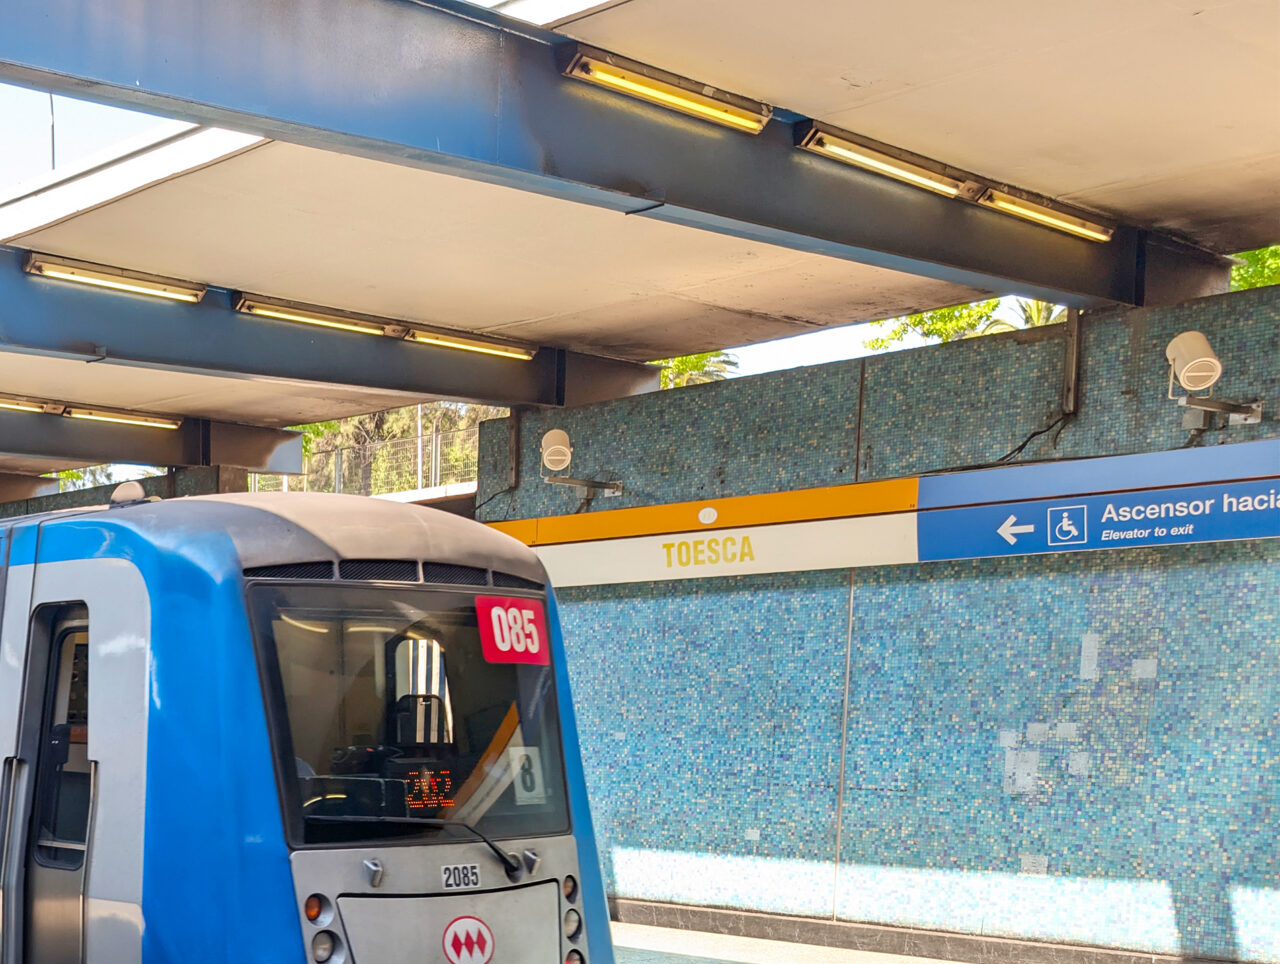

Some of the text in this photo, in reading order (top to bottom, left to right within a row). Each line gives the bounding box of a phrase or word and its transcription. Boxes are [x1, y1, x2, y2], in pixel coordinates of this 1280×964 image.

[1101, 489, 1280, 523] Ascensor haci
[1101, 524, 1194, 541] Elevator to exit
[662, 536, 755, 568] TOESCA
[491, 606, 539, 654] 085
[443, 865, 479, 888] 2085
